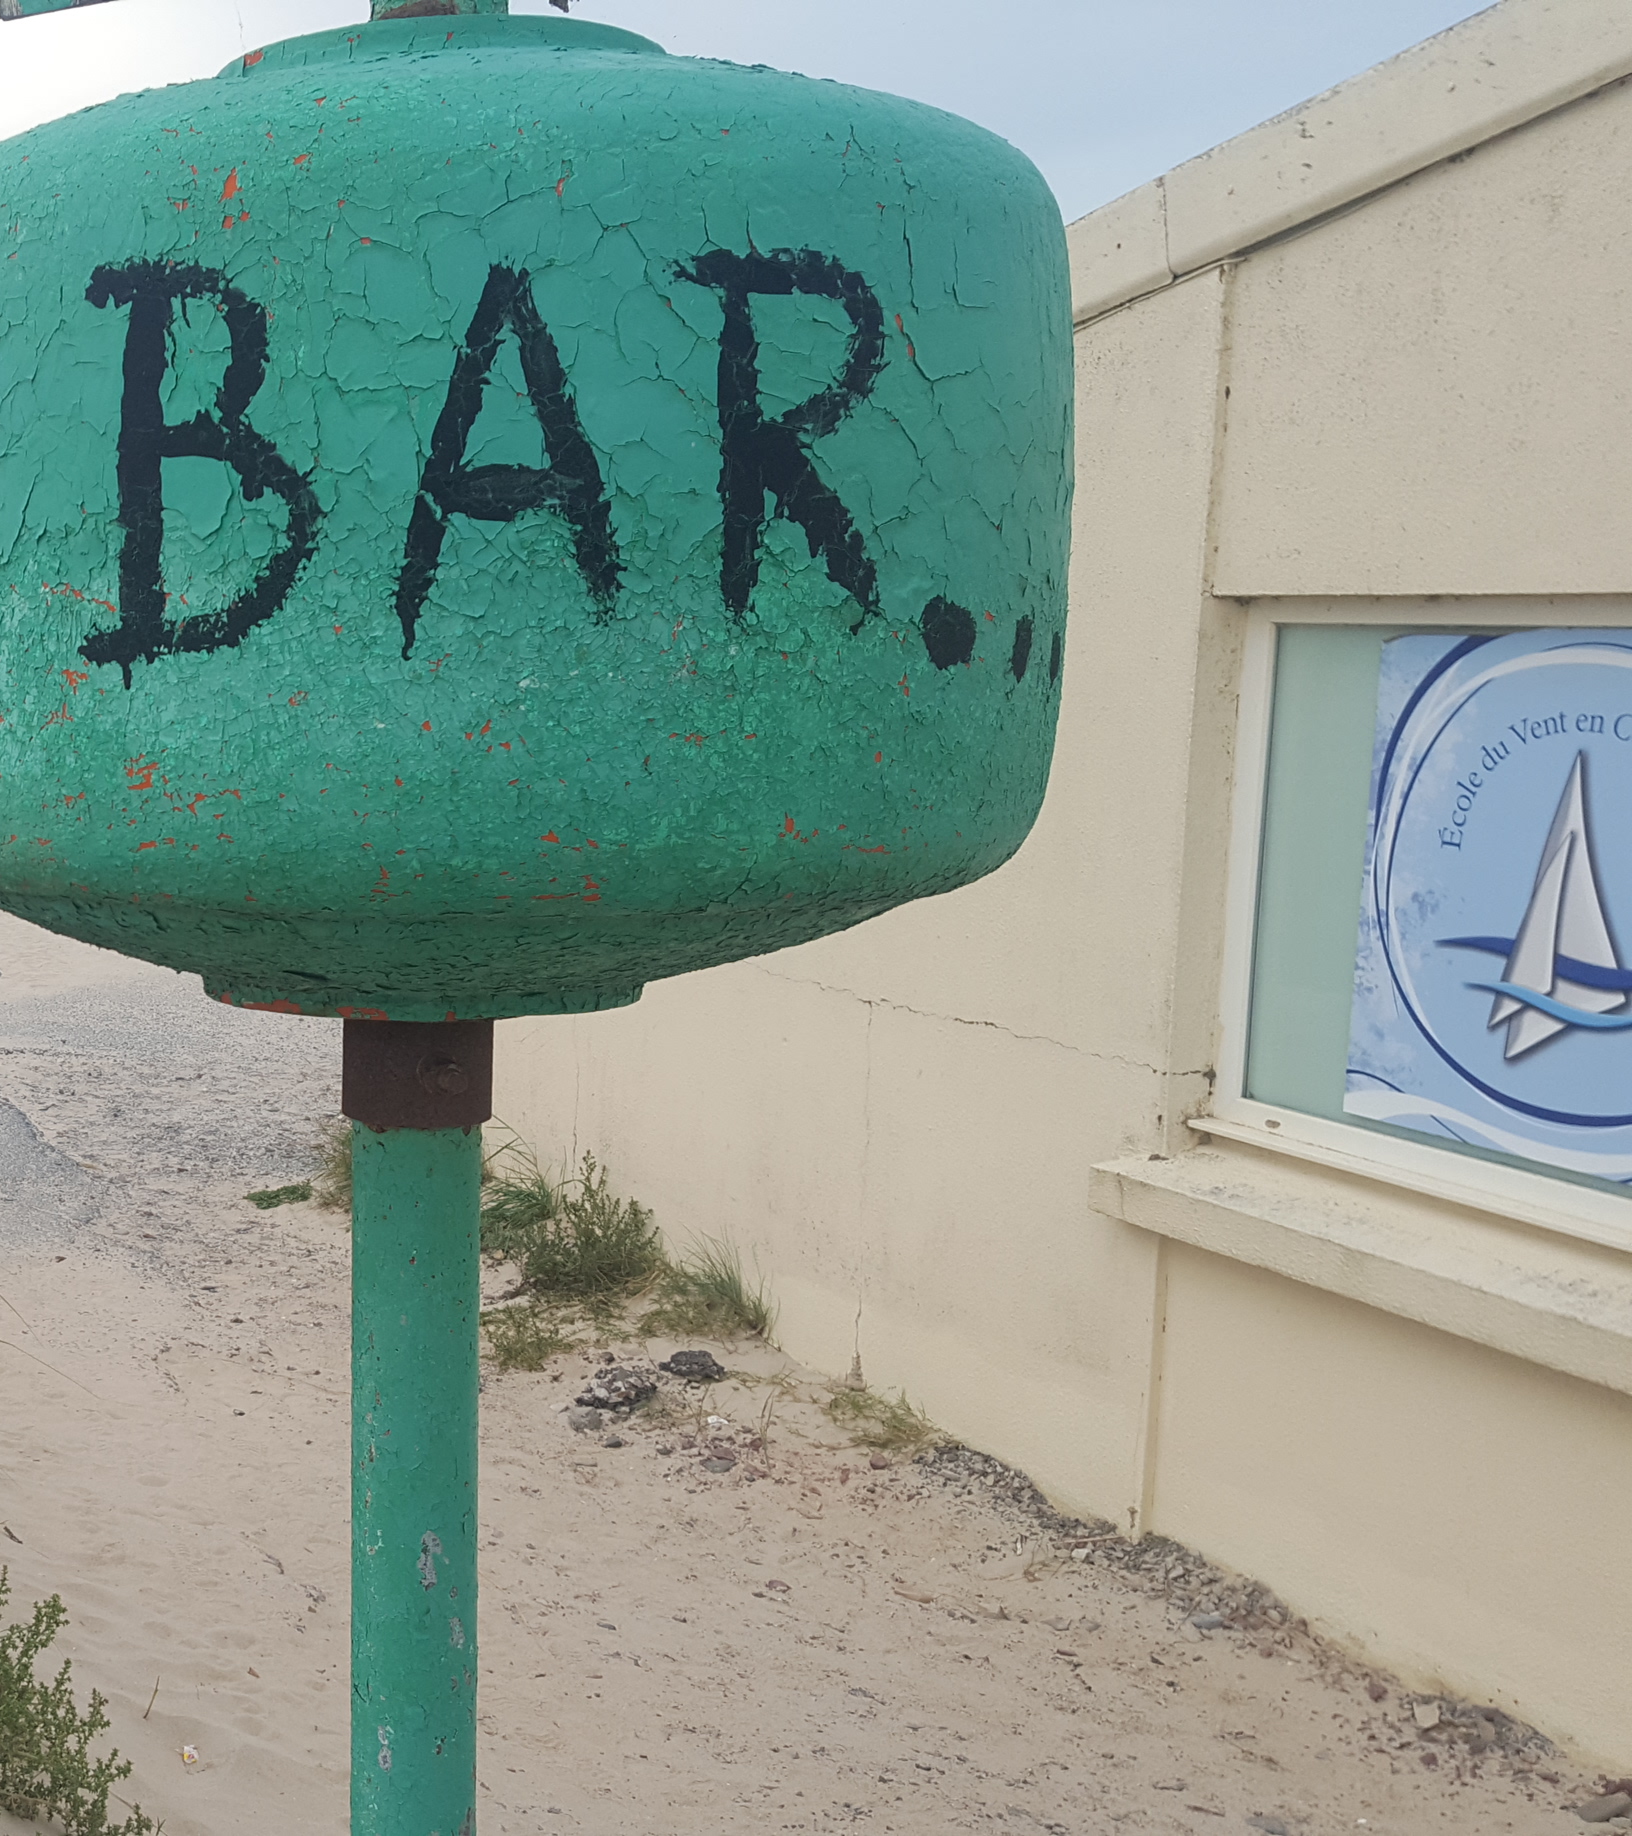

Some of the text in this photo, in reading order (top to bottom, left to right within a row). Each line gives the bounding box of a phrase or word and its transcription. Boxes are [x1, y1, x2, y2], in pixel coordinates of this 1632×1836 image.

[1438, 771, 1484, 852] École
[1481, 740, 1511, 772] du
[1508, 711, 1568, 745] Vent
[1575, 713, 1605, 735] en
